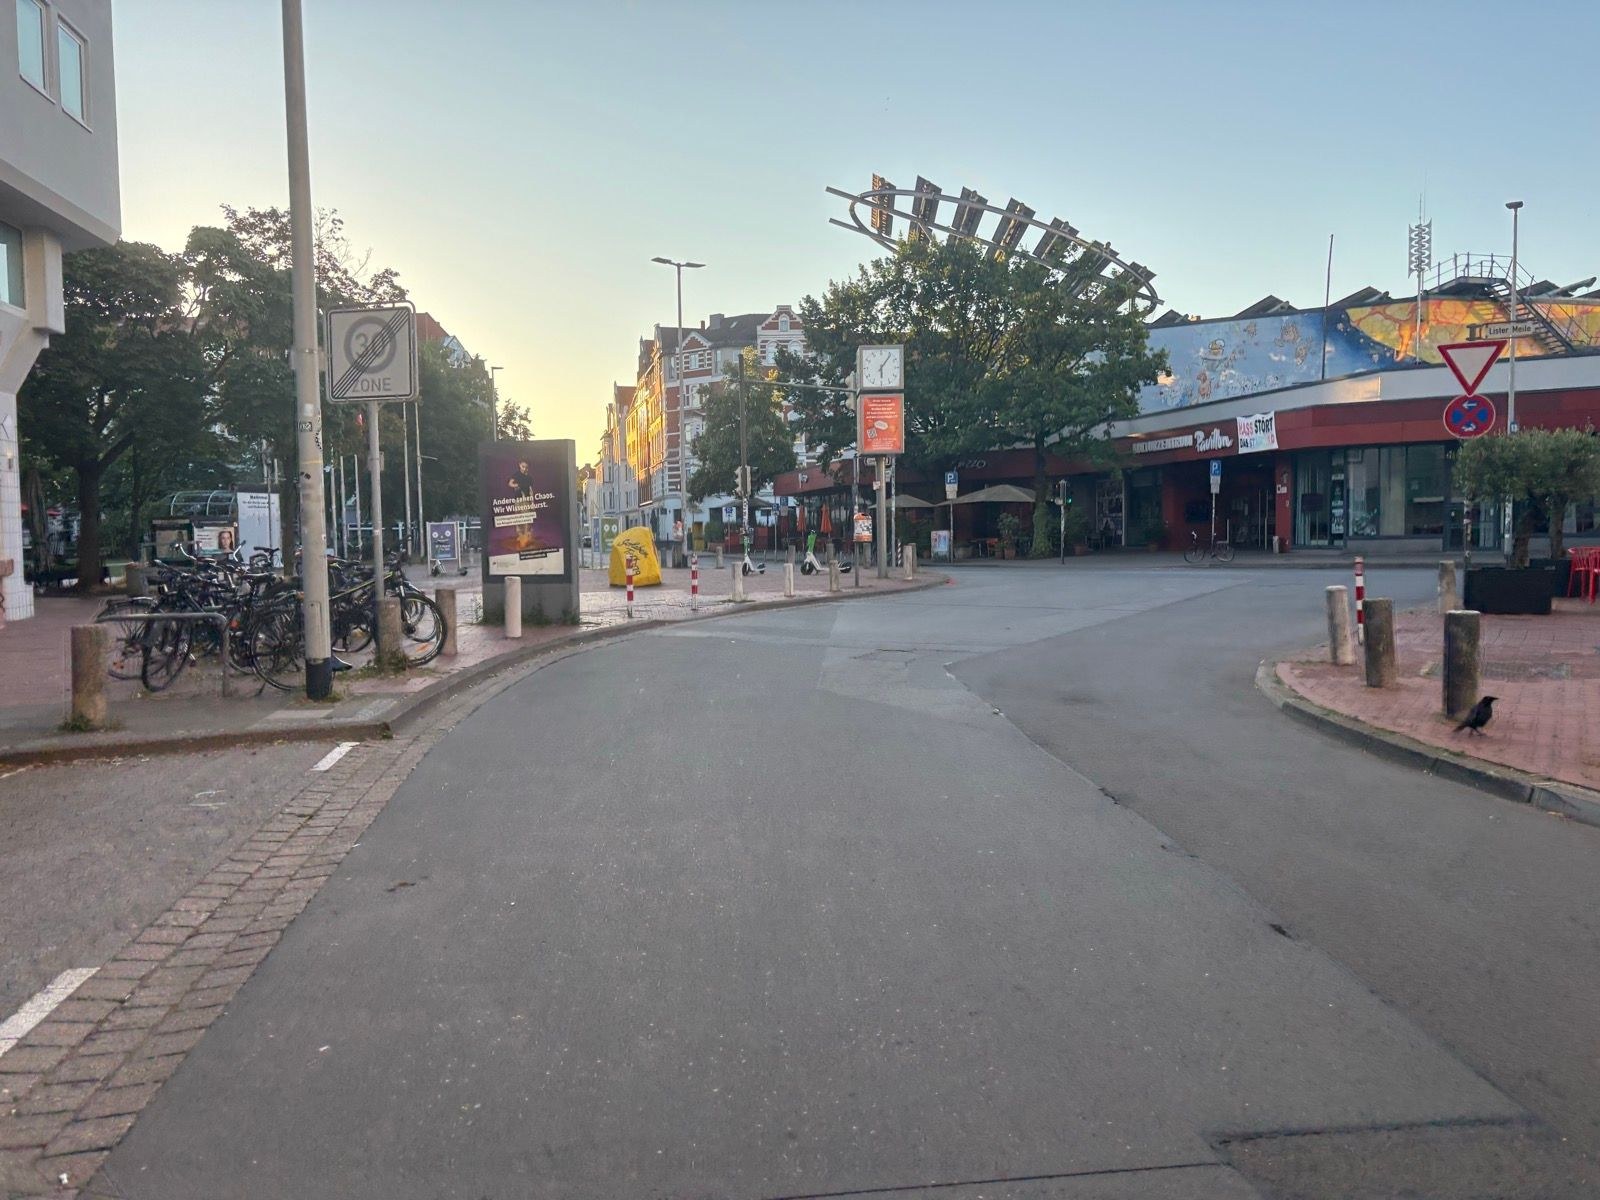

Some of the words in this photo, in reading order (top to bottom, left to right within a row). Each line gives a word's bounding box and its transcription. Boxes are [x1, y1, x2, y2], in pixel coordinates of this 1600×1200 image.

[1489, 327, 1508, 335] Lister
[1512, 325, 1531, 333] Meile
[353, 377, 392, 393] ZONE
[1254, 416, 1273, 434] STÖRT
[1194, 428, 1233, 453] Pavillon
[493, 497, 516, 506] Andere
[516, 495, 534, 503] sehen
[534, 492, 556, 500] Chaos.
[493, 506, 505, 514] Wir
[505, 501, 549, 513] Wissensdurst.
